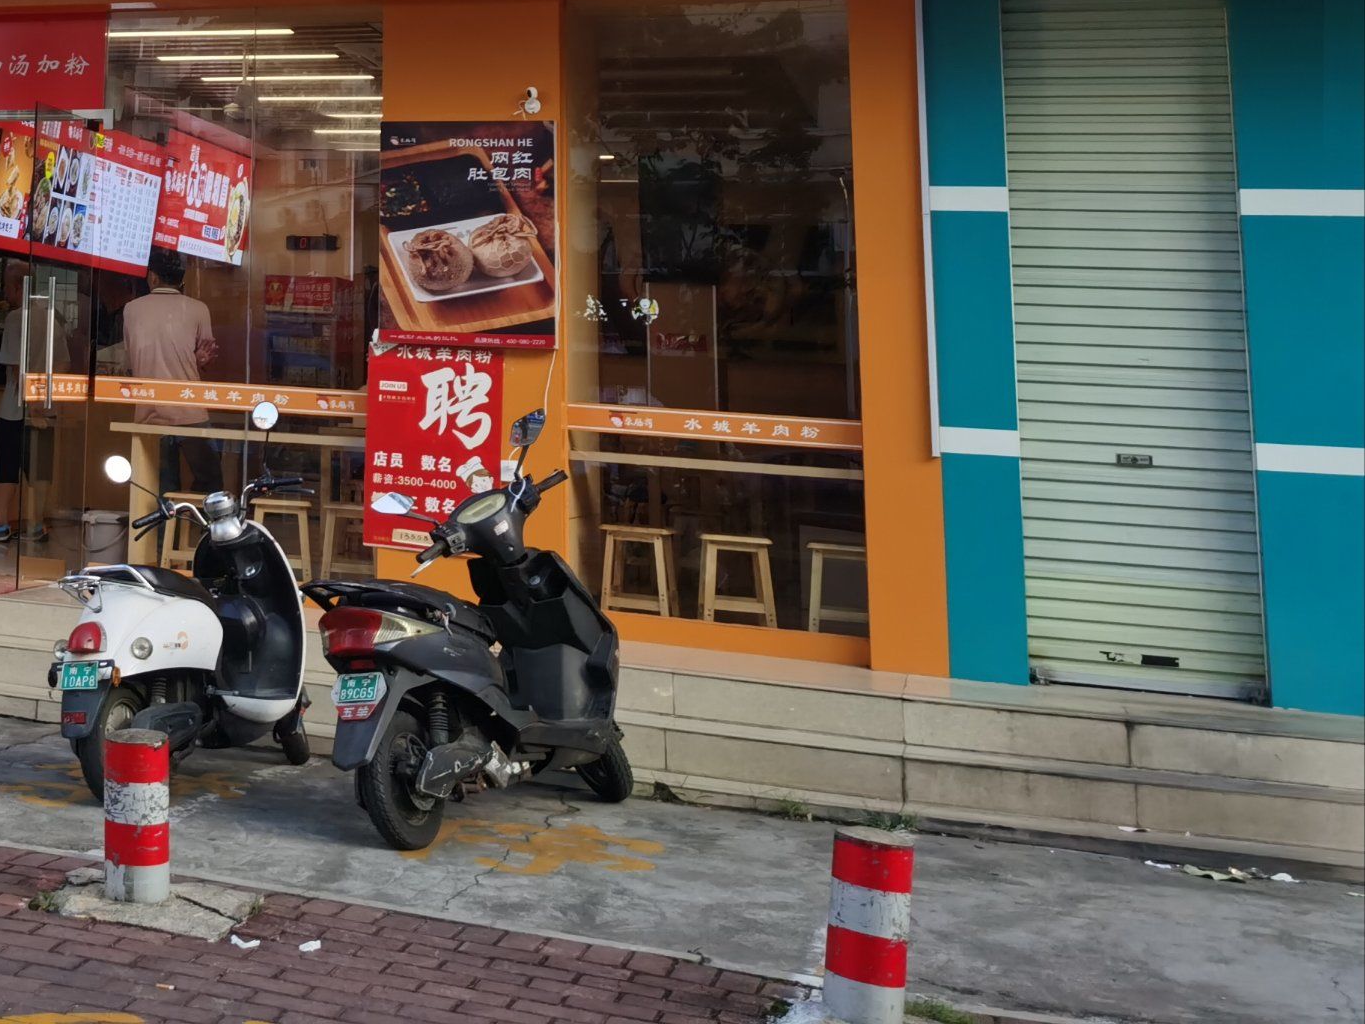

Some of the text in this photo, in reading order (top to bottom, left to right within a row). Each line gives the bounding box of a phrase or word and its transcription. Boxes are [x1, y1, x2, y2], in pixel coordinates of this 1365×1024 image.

[449, 137, 534, 148] RONGSHAN HE
[490, 150, 534, 165] 网红
[467, 167, 532, 181] 肚包肉
[397, 345, 494, 364] 水城羊肉粉
[420, 362, 493, 450] 聘
[684, 418, 820, 439] 水城羊肉粉
[374, 451, 451, 473] 店员 数名
